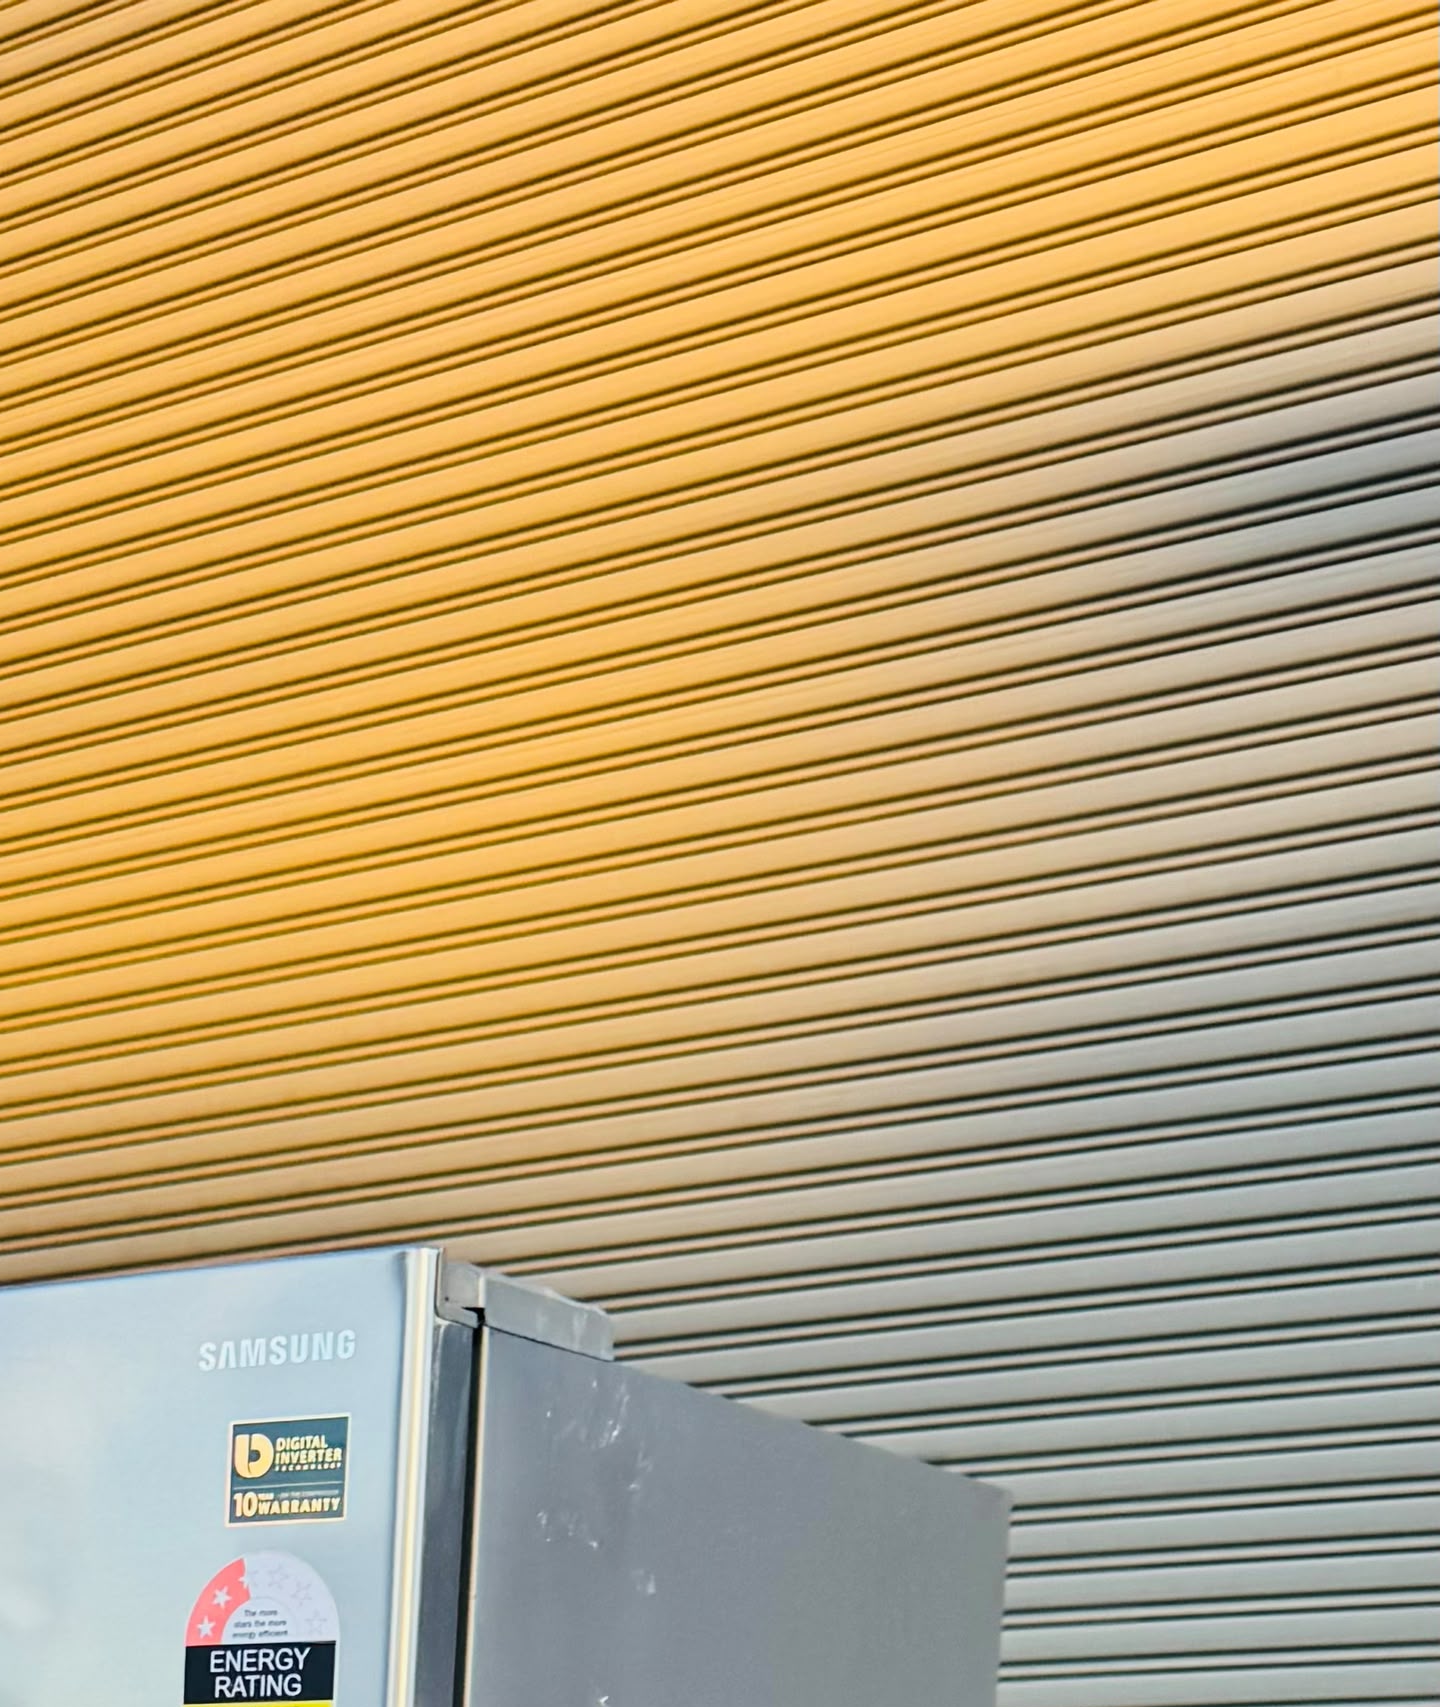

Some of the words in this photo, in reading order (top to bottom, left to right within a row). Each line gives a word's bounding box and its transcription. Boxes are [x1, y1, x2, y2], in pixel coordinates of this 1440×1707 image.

[199, 1329, 356, 1372] SAMSUNG
[276, 1434, 328, 1451] DIGITAL
[275, 1448, 342, 1465] INVERTER
[234, 1491, 258, 1518] 10
[258, 1498, 341, 1515] WARRANTY
[210, 1647, 311, 1673] ENERGY
[214, 1674, 302, 1699] RATING
